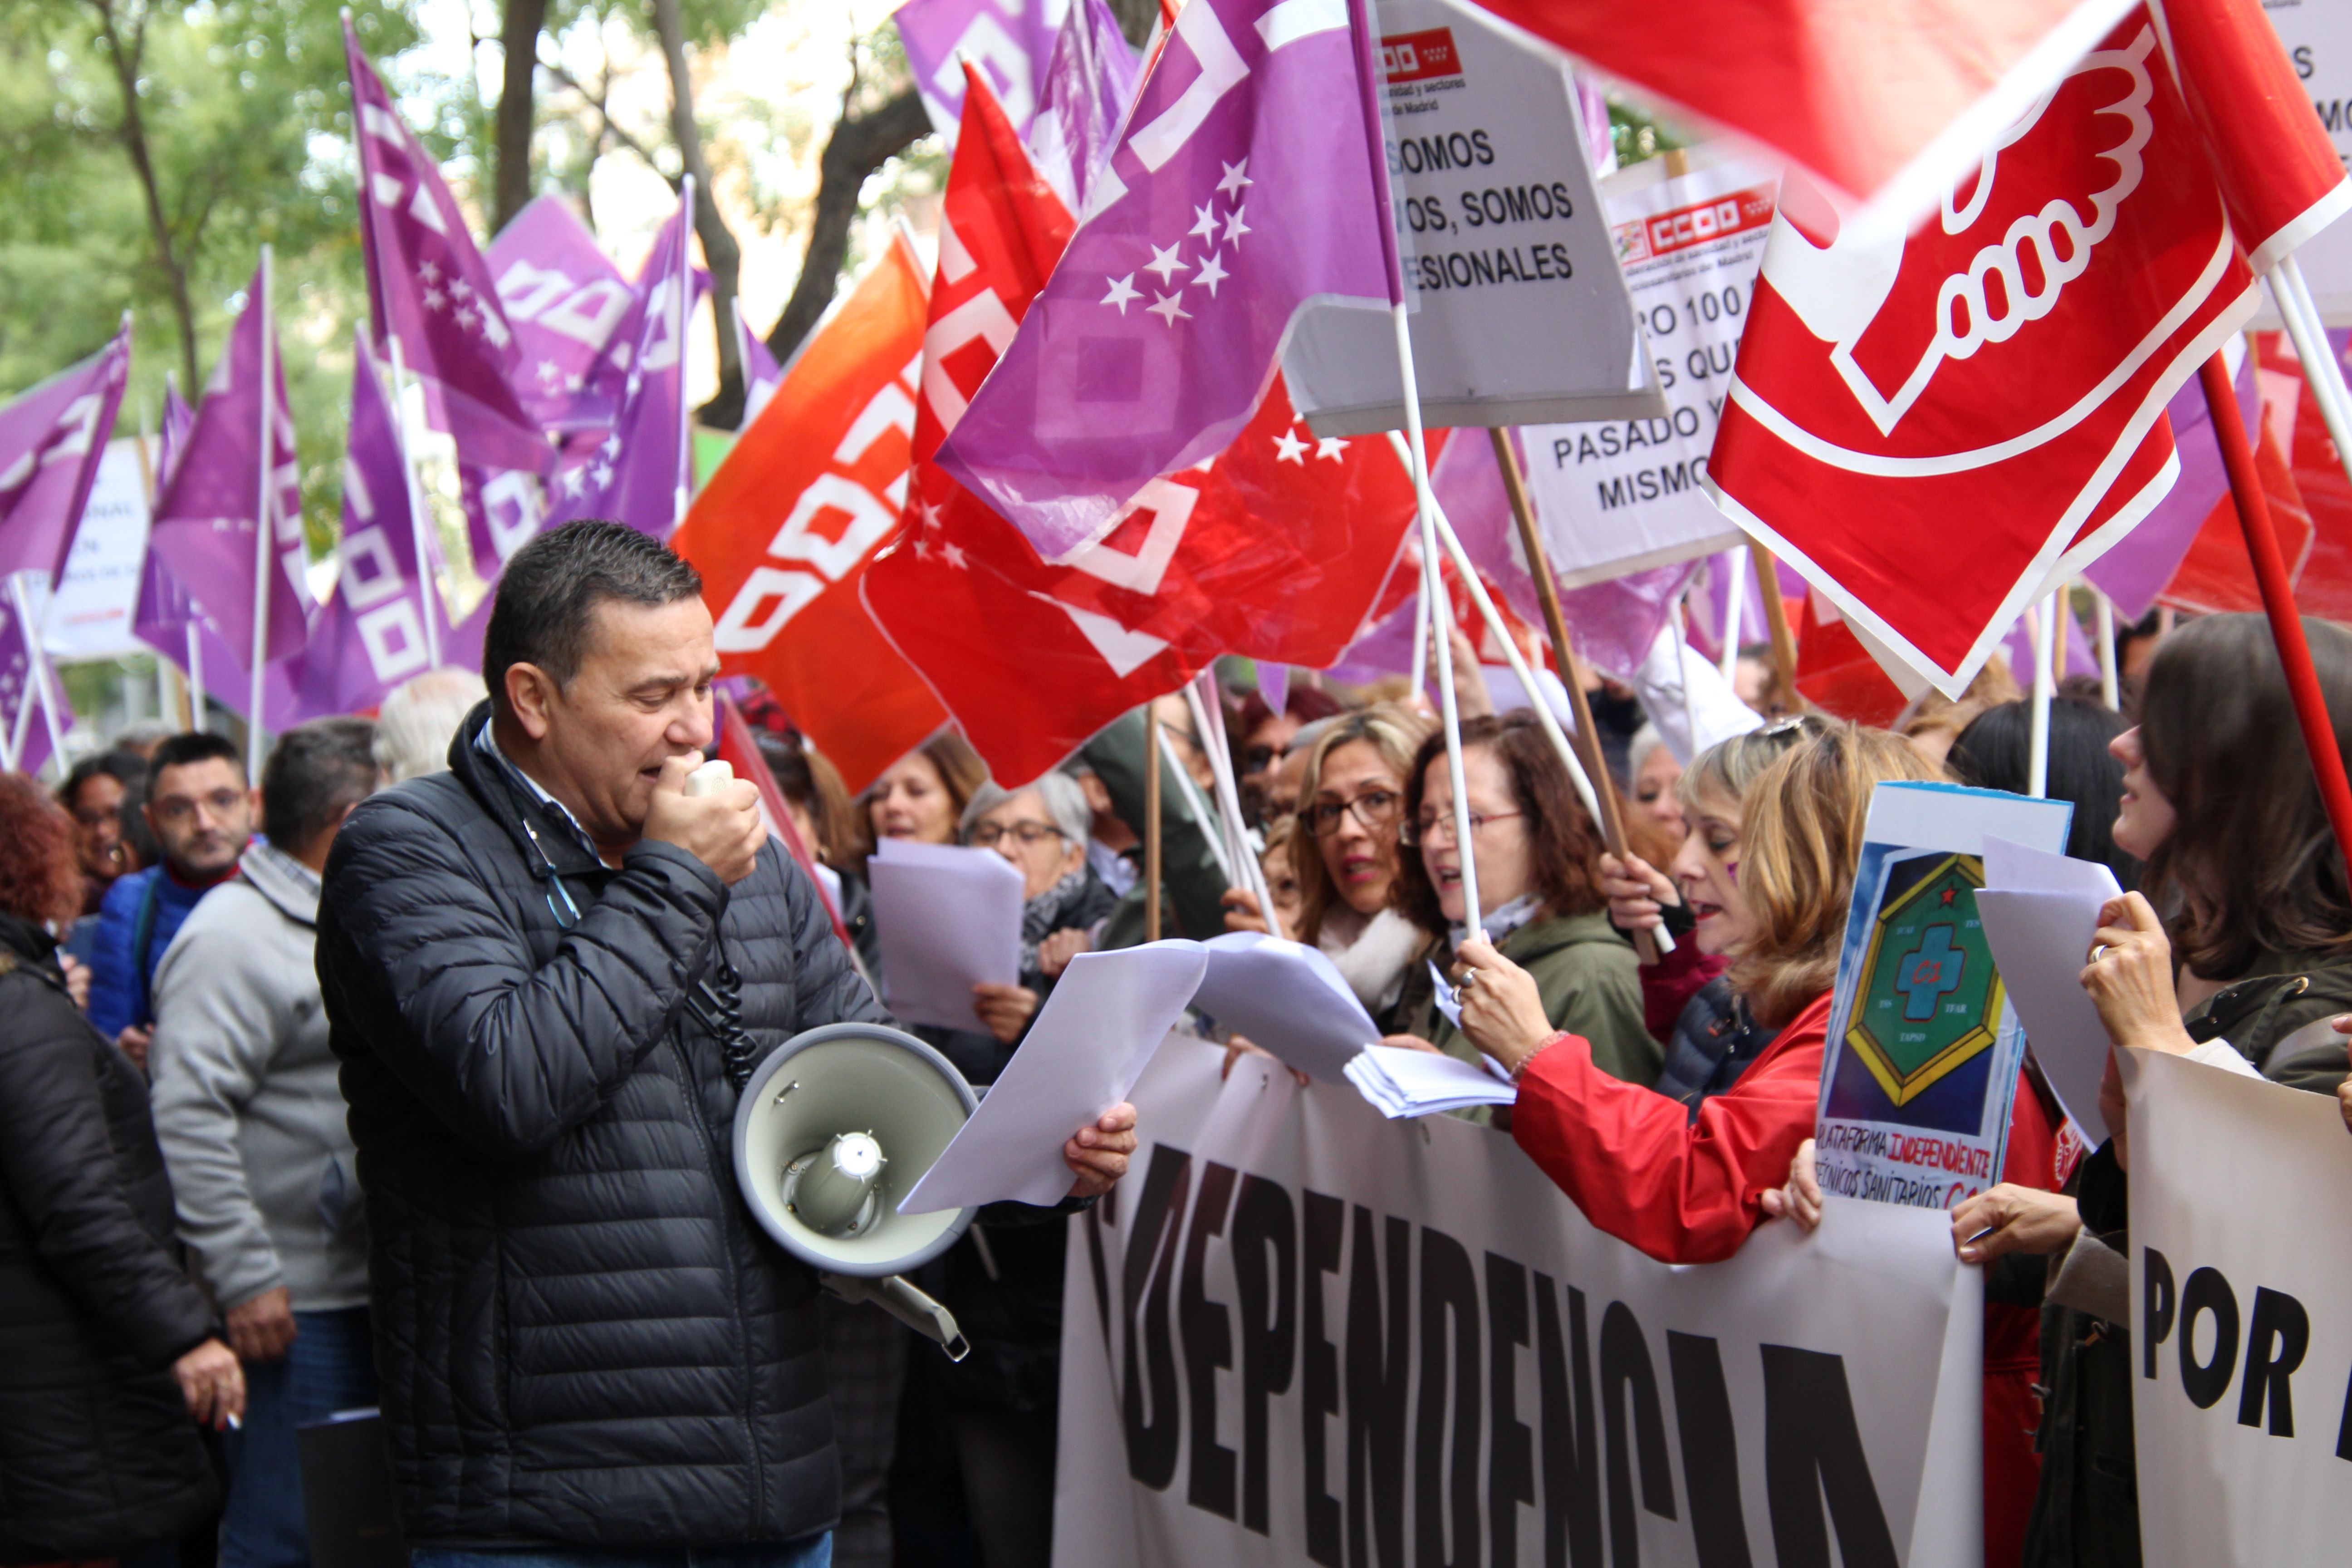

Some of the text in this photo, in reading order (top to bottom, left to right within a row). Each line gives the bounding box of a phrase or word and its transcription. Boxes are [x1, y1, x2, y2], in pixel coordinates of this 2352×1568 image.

[1461, 182, 1573, 226] SOMOS
[1403, 243, 1573, 290] ESIONALES
[1686, 286, 1741, 326] 100
[1554, 406, 1699, 469] PASADO
[1815, 1124, 1887, 1157] PLATAFORMA
[2144, 1245, 2311, 1438] POR
